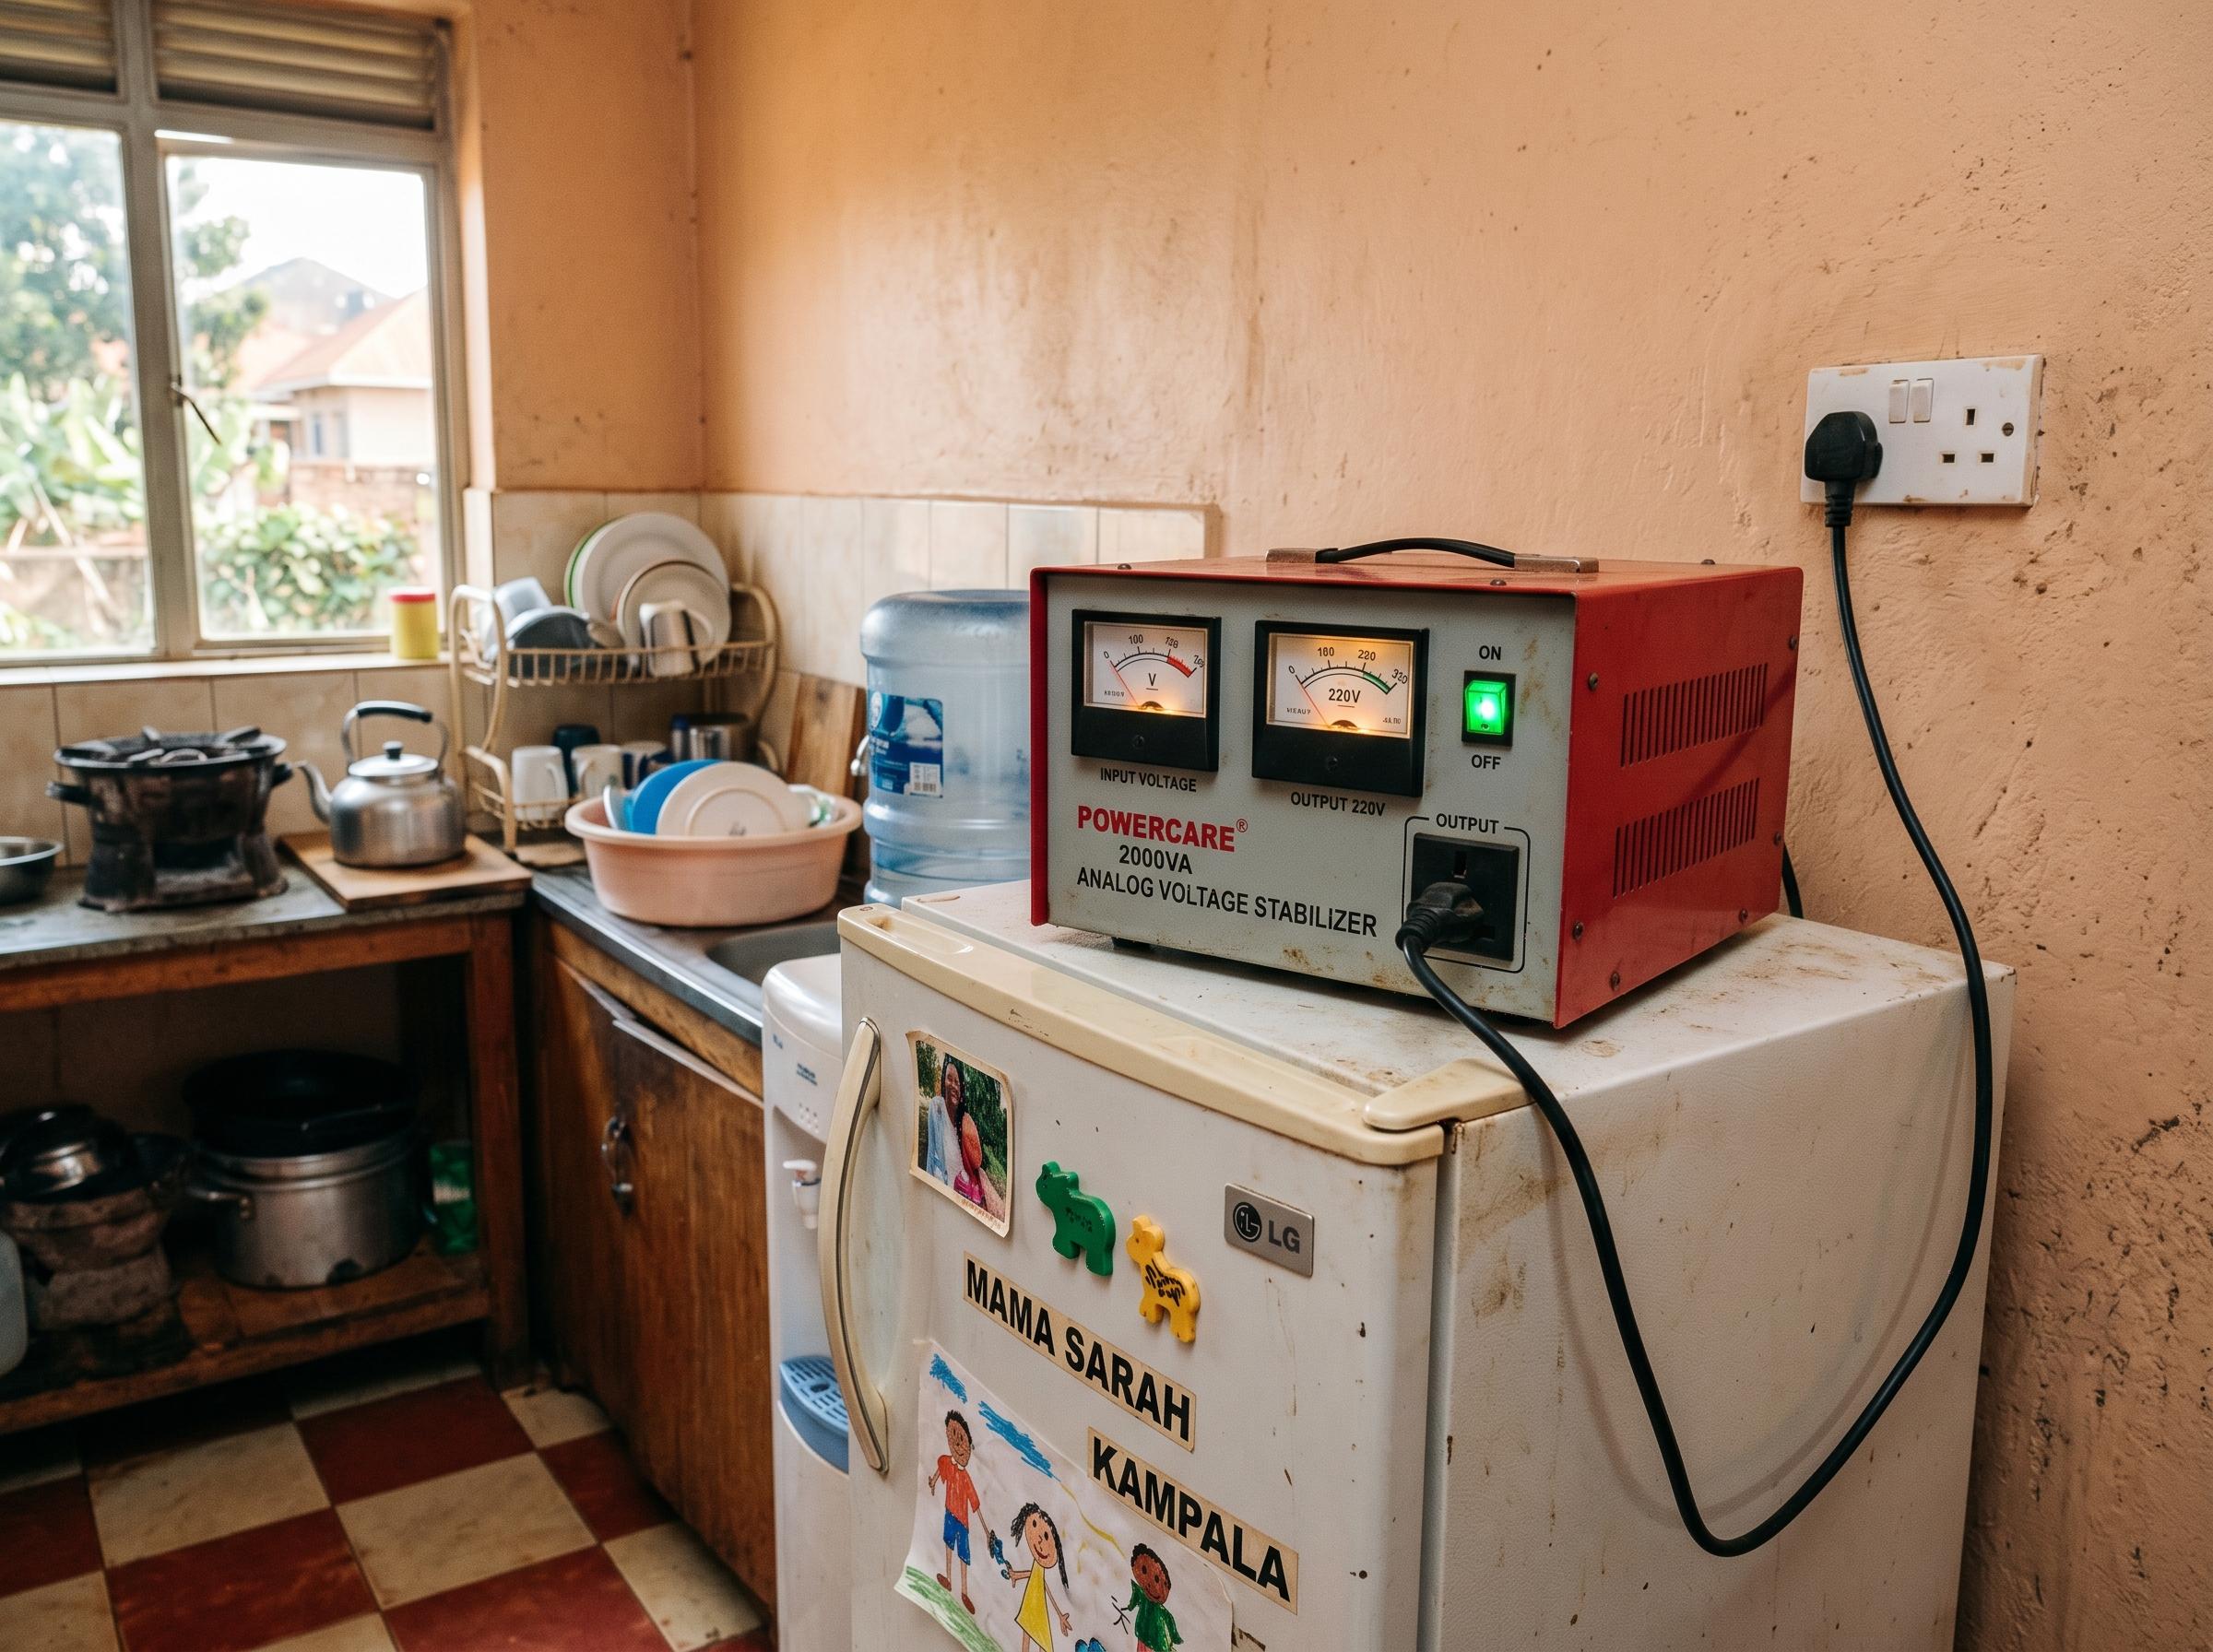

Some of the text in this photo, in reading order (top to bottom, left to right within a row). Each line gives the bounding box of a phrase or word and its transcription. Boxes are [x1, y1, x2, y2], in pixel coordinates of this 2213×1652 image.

[1129, 634, 1143, 644] 100
[1358, 649, 1376, 661] 220
[1479, 645, 1502, 661] ON
[1148, 672, 1156, 687] V
[1328, 688, 1361, 703] 220V
[1472, 754, 1501, 770] OFF
[1100, 767, 1197, 793] INPUT VOLTAGE
[1290, 791, 1386, 817] OUTPUT 220V
[1436, 813, 1499, 835] OUTPUT
[1118, 844, 1193, 875] 2000VA
[1076, 867, 1378, 938] ANALOG VOLTAGE STABILIZER
[1268, 1220, 1300, 1254] LG
[967, 1260, 1056, 1356] MAMA
[1065, 1326, 1191, 1443] SARAH
[1093, 1436, 1291, 1603] KAMPALA
